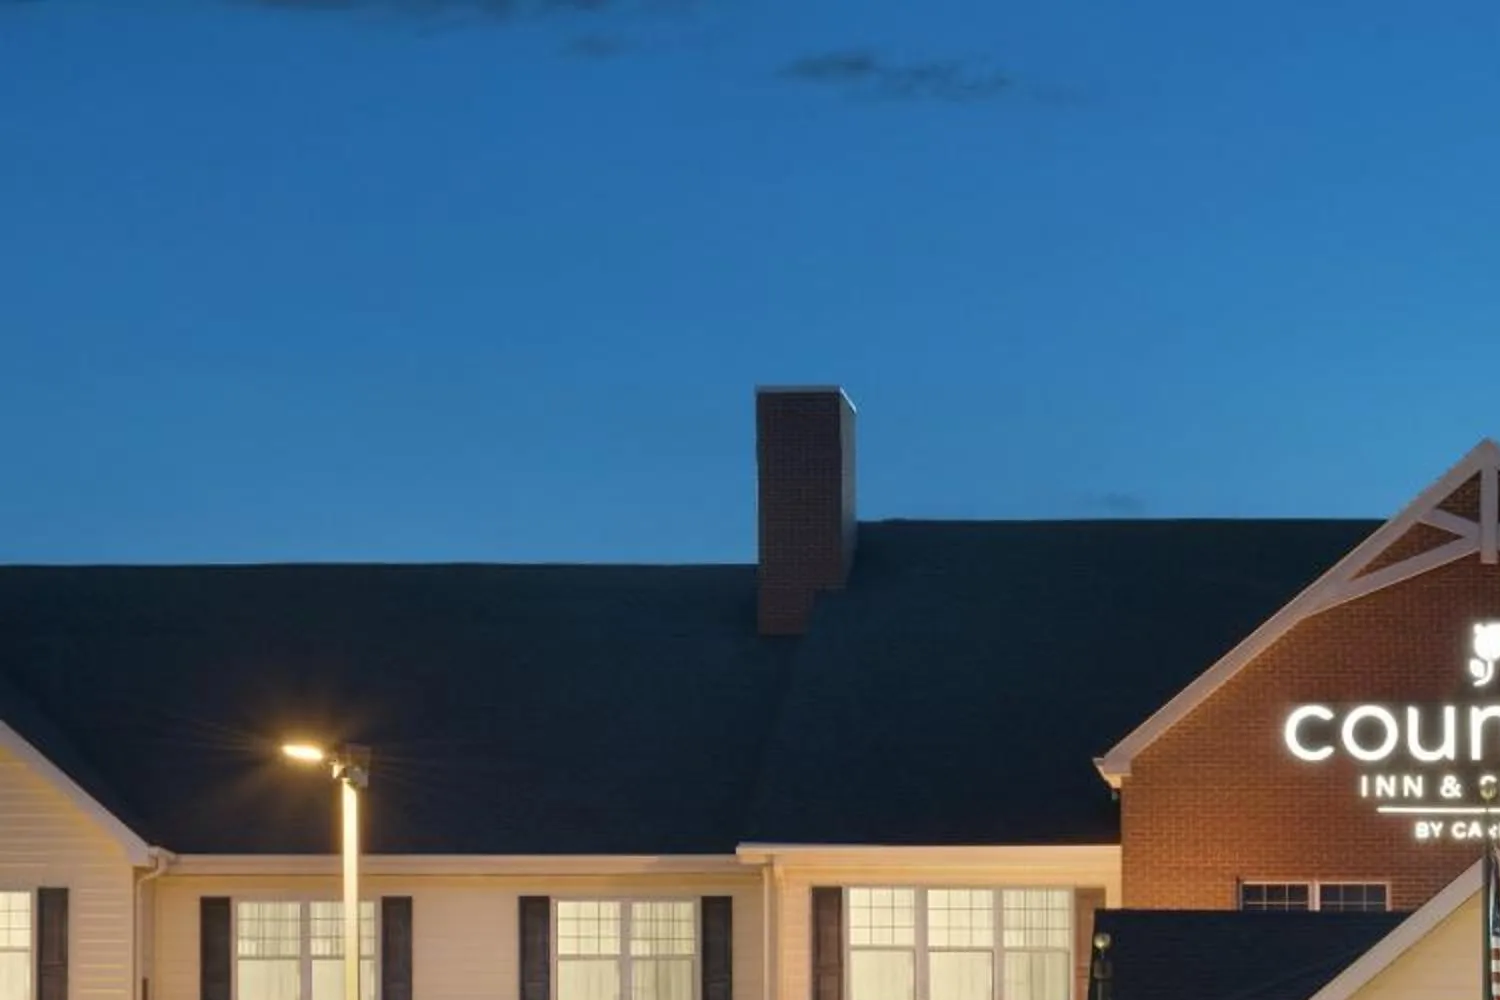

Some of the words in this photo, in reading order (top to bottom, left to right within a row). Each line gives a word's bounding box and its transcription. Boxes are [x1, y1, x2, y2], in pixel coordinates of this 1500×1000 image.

[1360, 774, 1424, 799] INN
[1439, 774, 1462, 799] &
[1414, 820, 1443, 840] BY
